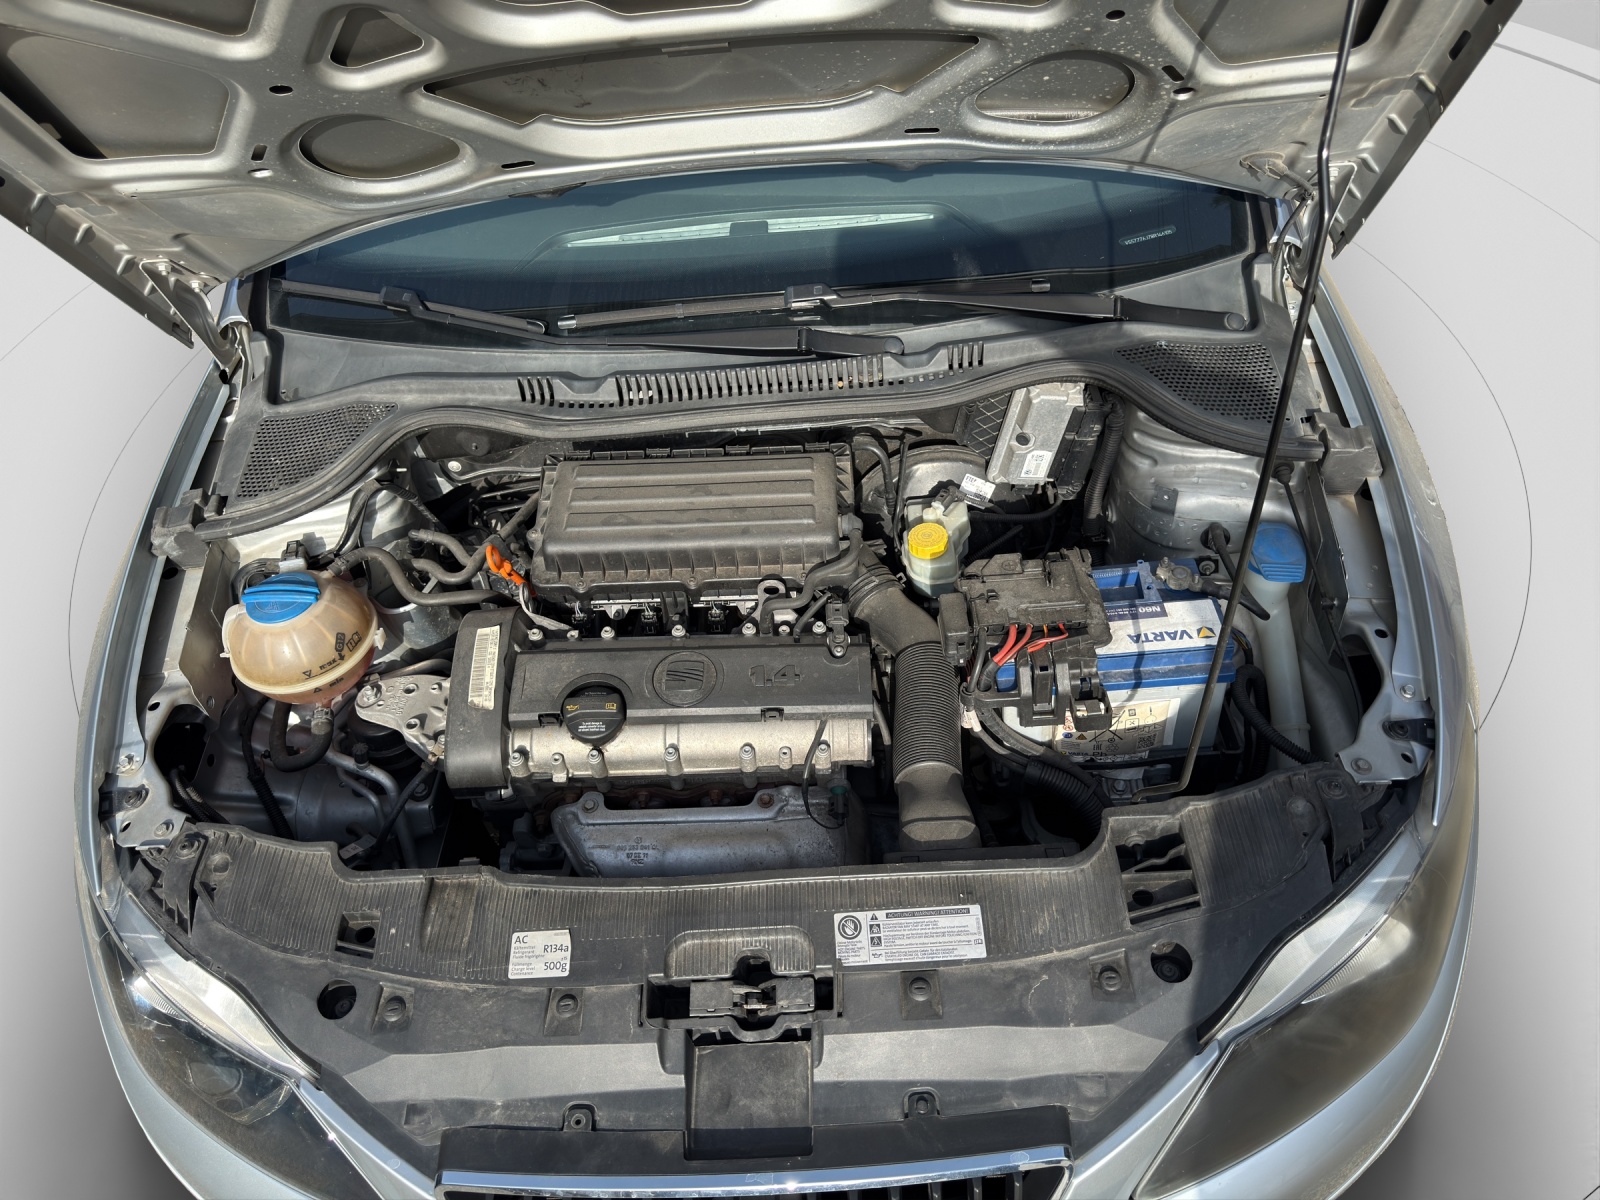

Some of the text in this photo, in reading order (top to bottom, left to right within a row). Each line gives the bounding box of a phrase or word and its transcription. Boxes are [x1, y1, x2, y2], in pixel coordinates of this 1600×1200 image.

[1138, 605, 1161, 613] N60
[1127, 629, 1194, 644] VARTA
[319, 658, 337, 671] max
[748, 664, 801, 687] 1.4
[329, 677, 345, 688] min
[514, 935, 528, 944] AC
[543, 944, 569, 953] R134a
[543, 961, 568, 973] 500g
